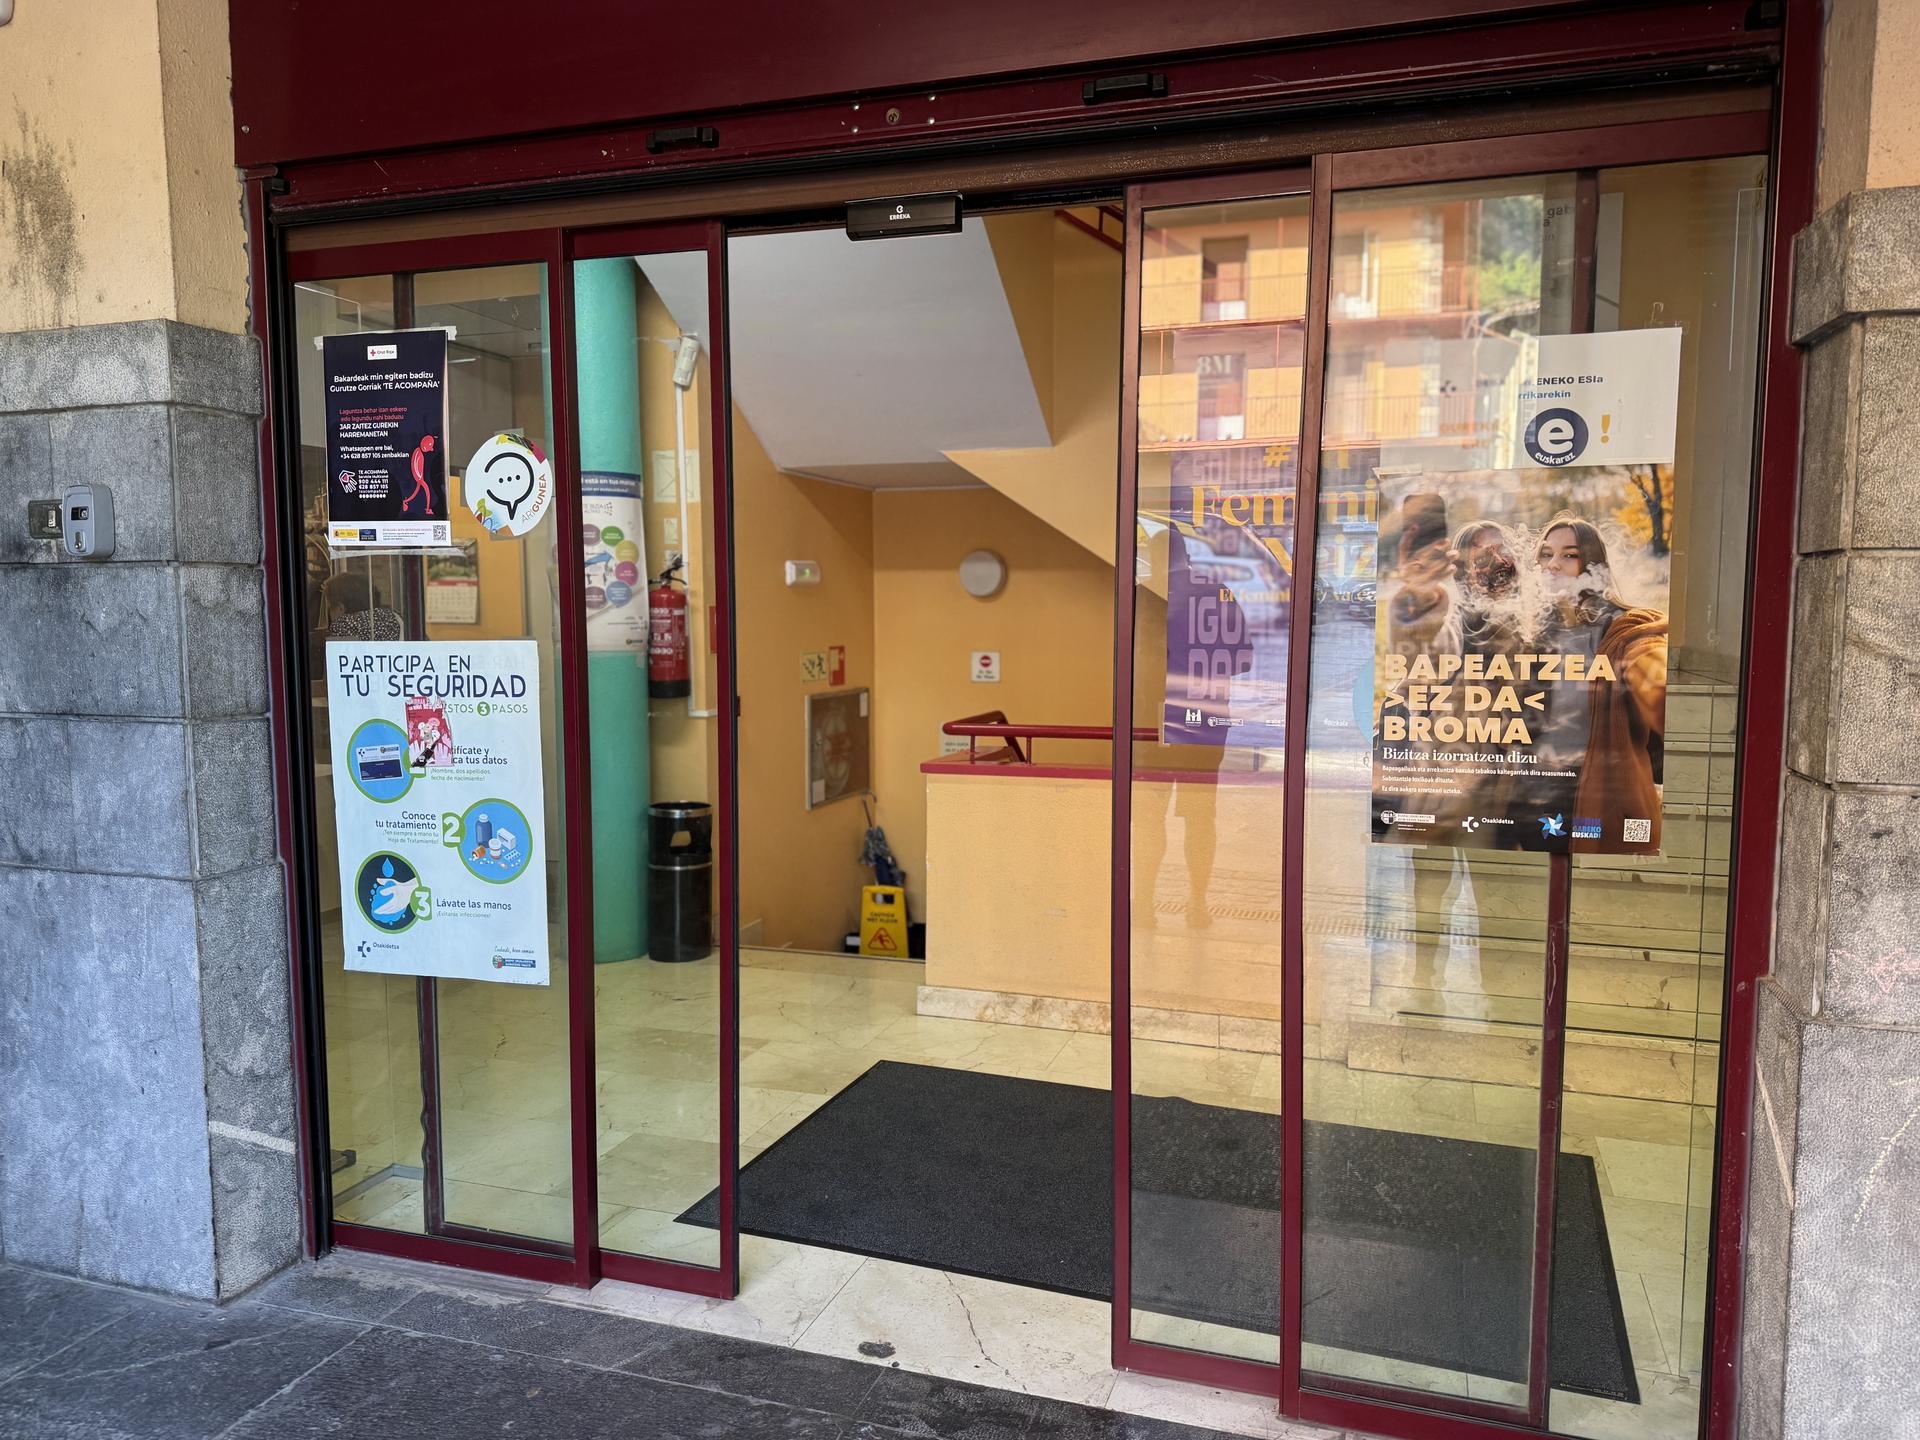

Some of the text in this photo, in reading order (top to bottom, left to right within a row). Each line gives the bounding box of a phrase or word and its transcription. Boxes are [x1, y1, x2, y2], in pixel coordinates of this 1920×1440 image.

[889, 213, 911, 221] ERREKA
[334, 371, 434, 383] Bakardeak min egiten badizu
[329, 385, 357, 393] Gurutze
[358, 383, 382, 392] Gorriak
[352, 422, 372, 430] ZAITEZ
[1534, 450, 1576, 465] euskaraz
[338, 655, 471, 673] PARTICIPA EN
[1384, 653, 1616, 681] BAPEATZEA
[340, 674, 527, 698] TU SEGURIDAD
[492, 704, 529, 714] PASOS
[1383, 716, 1533, 745] BROMA
[466, 756, 480, 765] tus
[482, 754, 508, 765] datos
[1382, 747, 1538, 764] Bizitza izorratzen dizu
[1497, 768, 1529, 777] kaltegarriak
[401, 811, 437, 821] Conoce
[1481, 817, 1515, 825] Osakidetza
[375, 820, 437, 830] tu tratamiento
[443, 816, 461, 843] 2
[414, 891, 431, 918] 3
[436, 898, 512, 911] Lávate las manos
